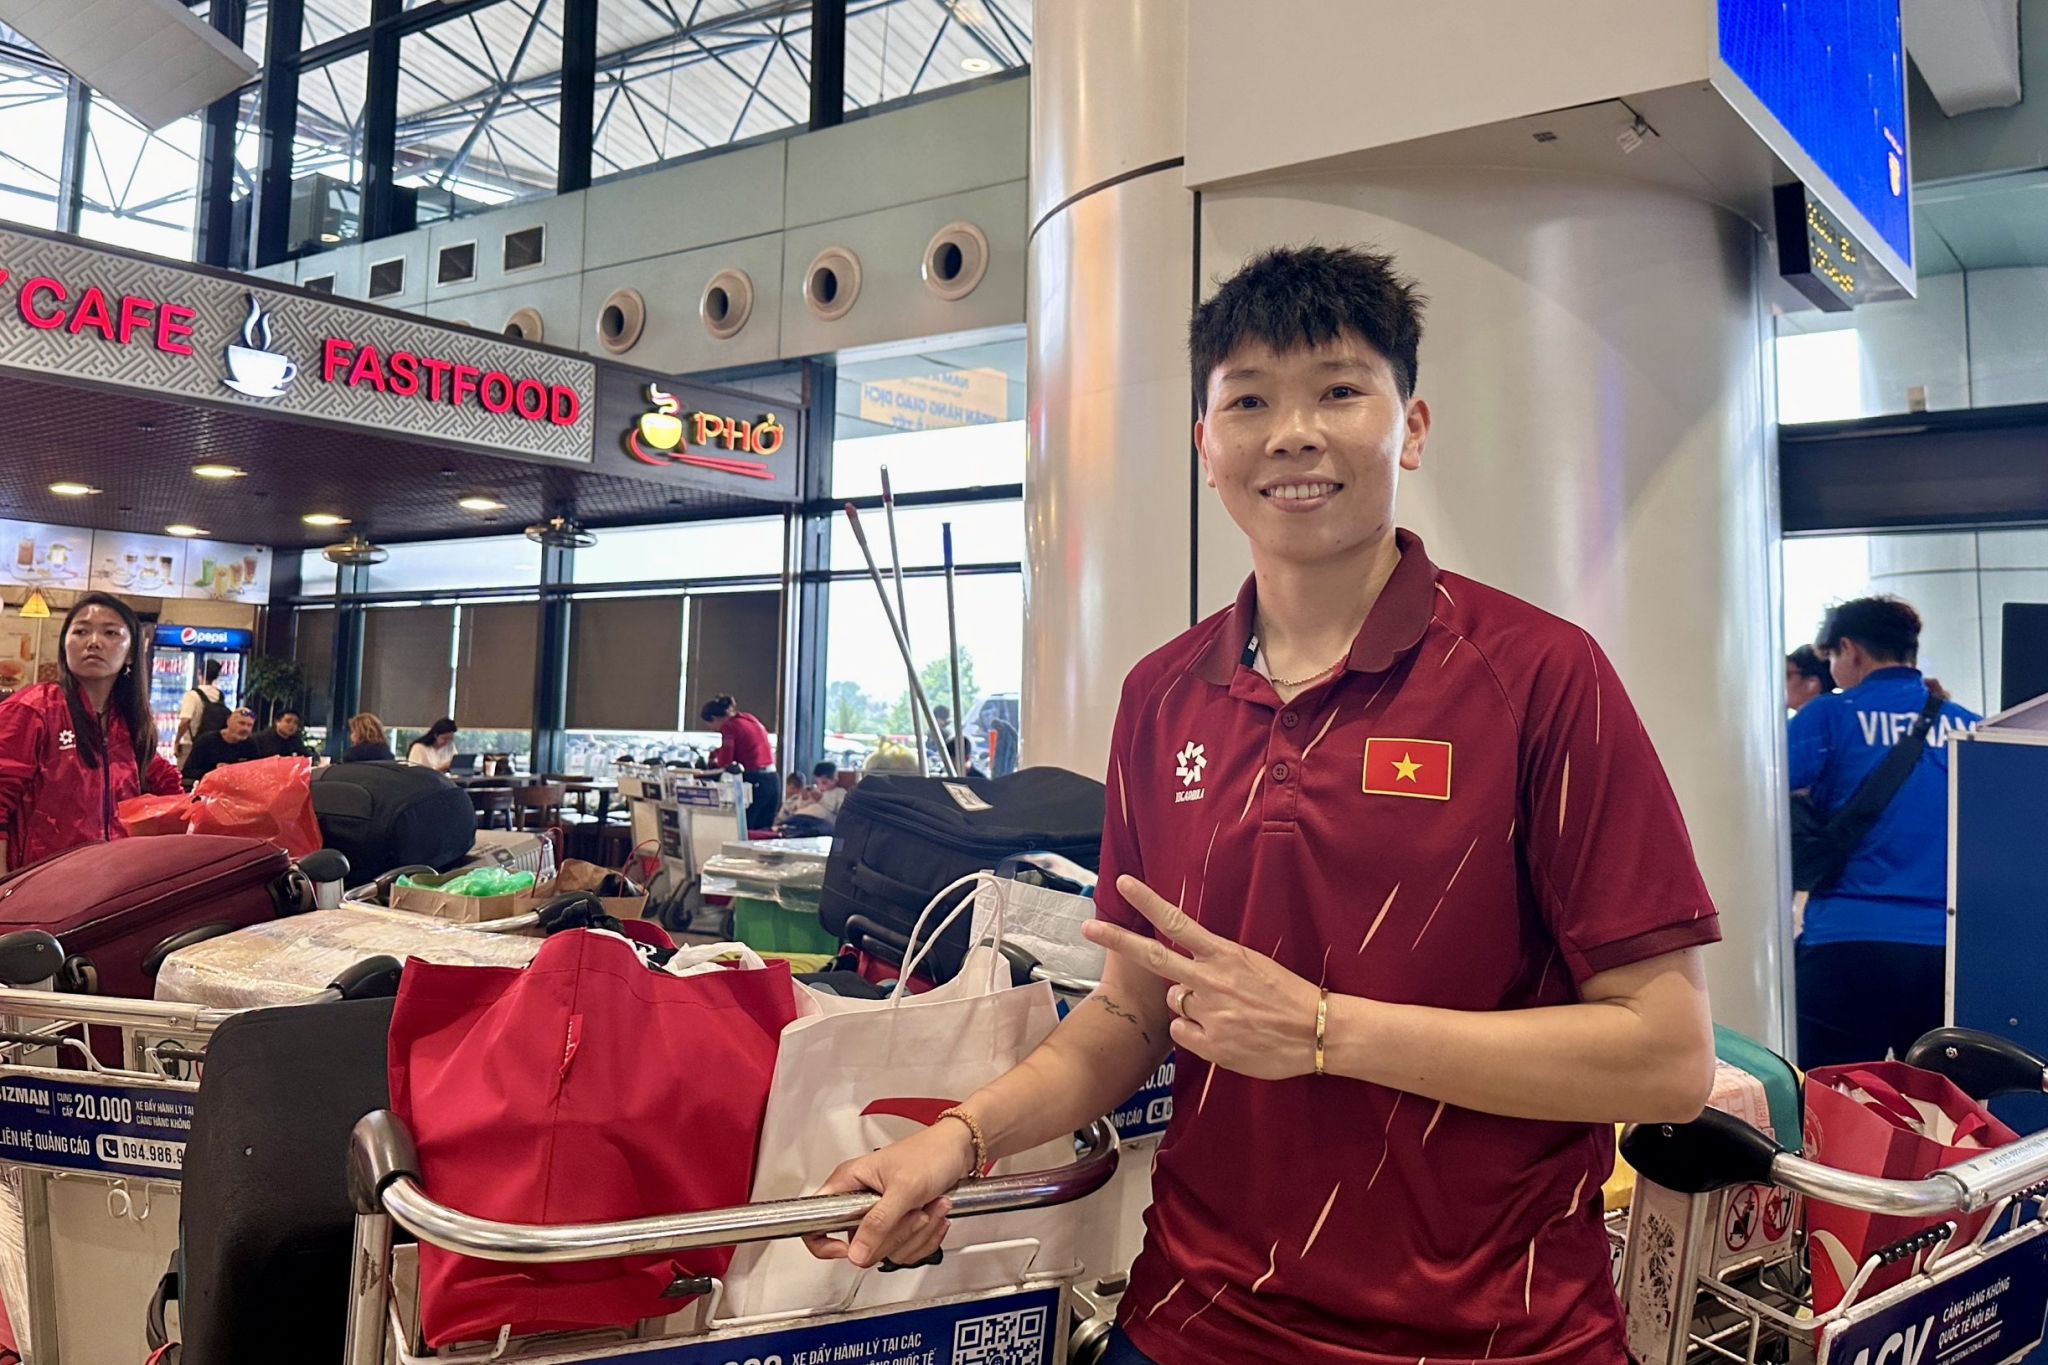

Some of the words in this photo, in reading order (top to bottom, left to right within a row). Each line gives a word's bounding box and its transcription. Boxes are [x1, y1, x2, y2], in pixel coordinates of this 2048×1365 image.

[19, 276, 196, 355] CAFE
[323, 337, 580, 426] FASTFOOD
[197, 632, 228, 643] pepsi
[0, 1086, 49, 1106] IZMAN
[57, 1092, 73, 1103] CUNG
[74, 1093, 132, 1124] 20.000
[135, 1100, 144, 1111] XE
[20, 1129, 34, 1151] HỆ
[35, 1130, 68, 1153] QUẢNG
[70, 1135, 91, 1156] CÁO
[792, 1352, 808, 1365] XE
[809, 1343, 832, 1365] ĐẨY
[834, 1342, 864, 1361] HÀNH
[866, 1337, 880, 1355] LÝ
[882, 1336, 899, 1354] TẠI
[901, 1332, 922, 1349] CÁC
[1938, 1320, 1960, 1349] QUỐC
